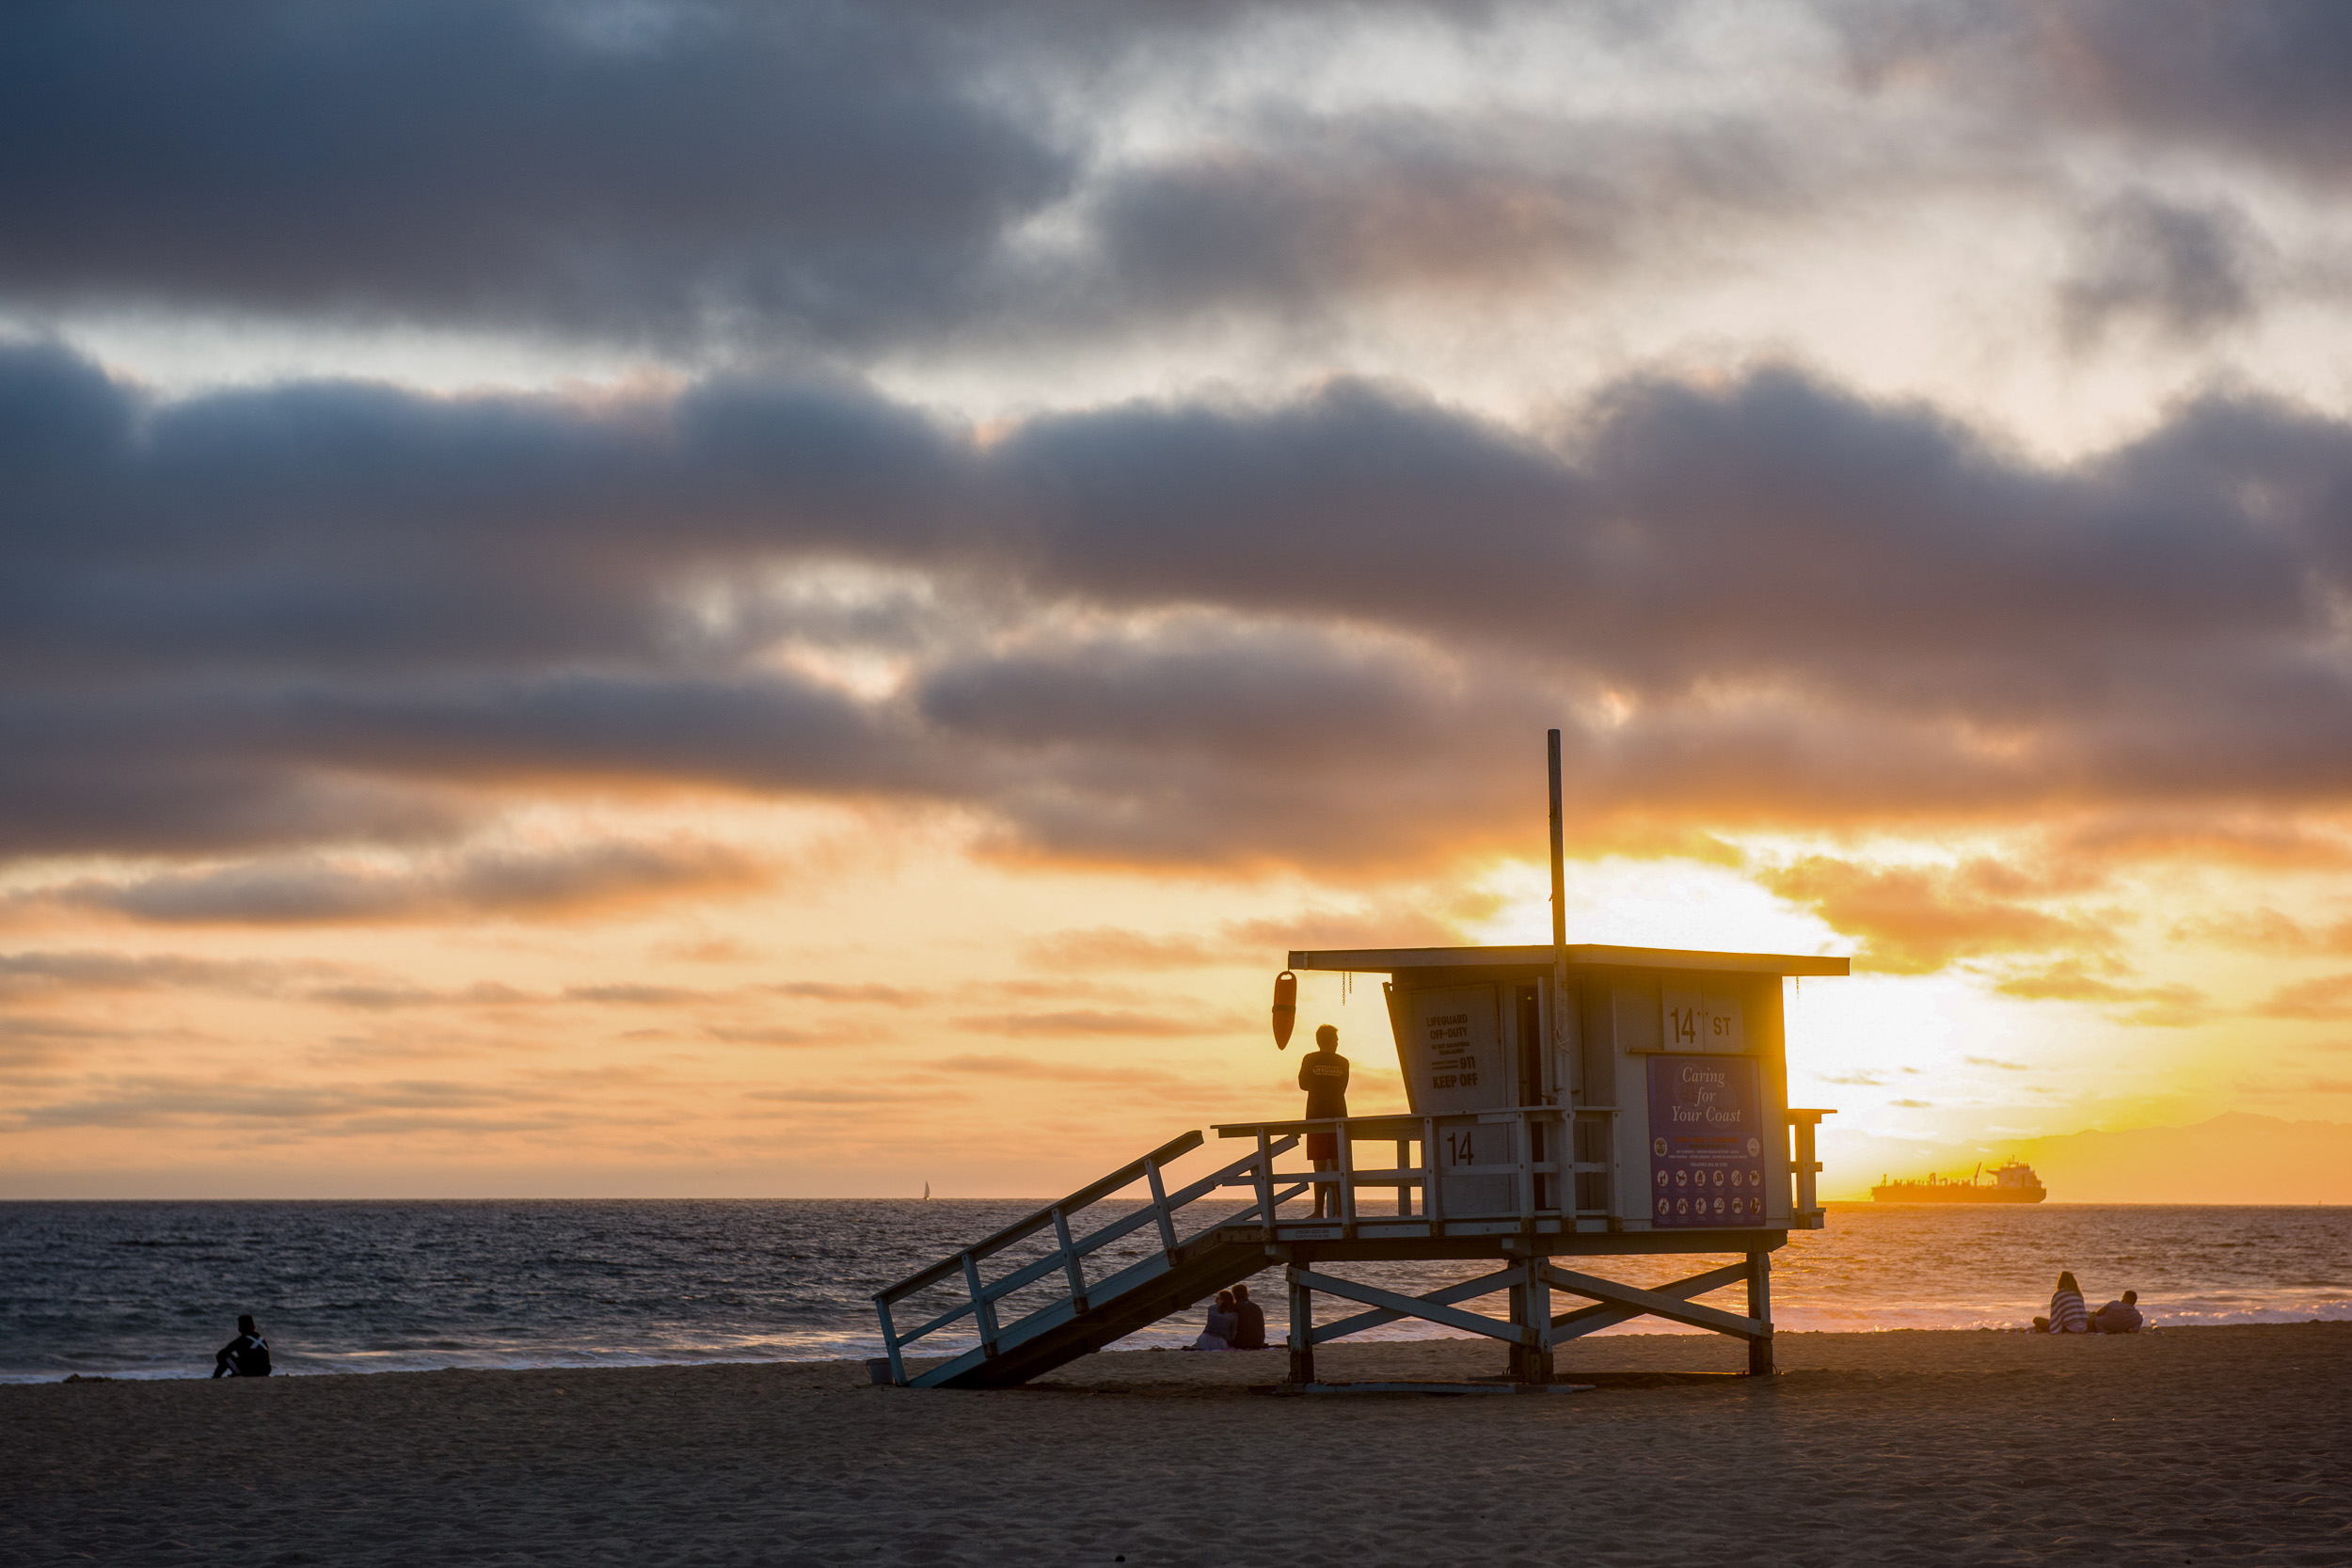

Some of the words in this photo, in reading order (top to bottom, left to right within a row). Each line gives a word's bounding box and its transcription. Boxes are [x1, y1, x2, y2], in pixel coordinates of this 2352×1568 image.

[1426, 1013, 1468, 1027] LIFEGUARD
[1670, 1006, 1696, 1044] 14
[1712, 1016, 1732, 1036] ST
[1430, 1026, 1468, 1039] OFF-DUTY
[1459, 1055, 1475, 1069] 911
[1432, 1074, 1457, 1089] KEEP
[1459, 1072, 1478, 1086] OFF
[1682, 1066, 1725, 1088] Caring
[1693, 1085, 1716, 1107] for
[1672, 1105, 1703, 1122] Your
[1706, 1105, 1741, 1122] Coast
[1447, 1131, 1474, 1166] 14
